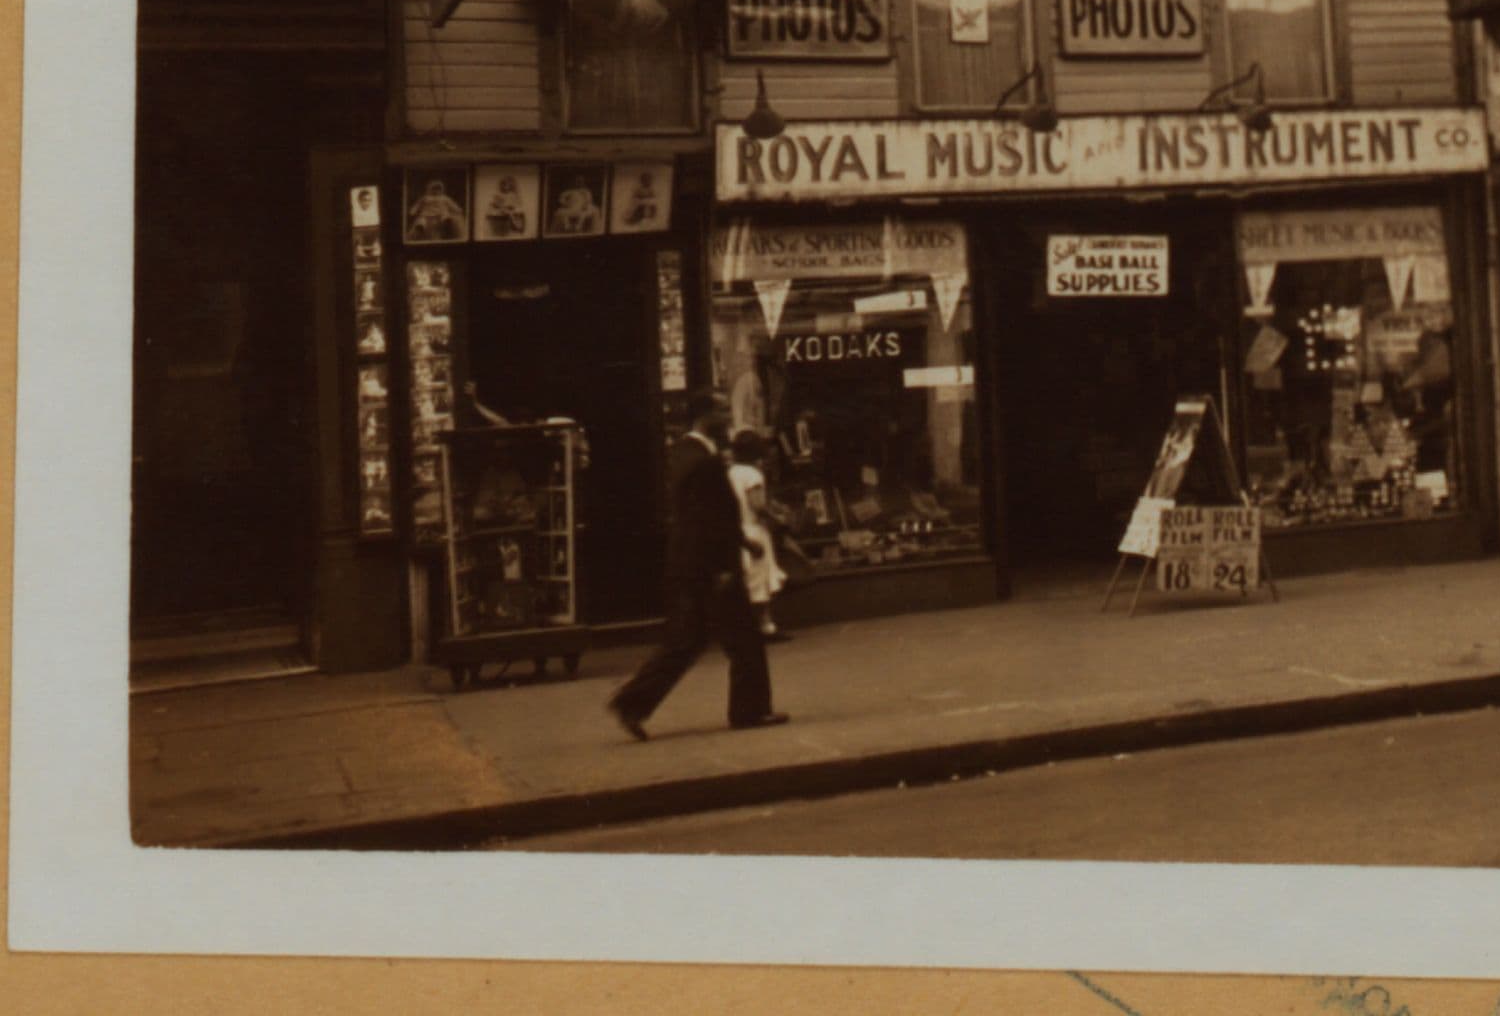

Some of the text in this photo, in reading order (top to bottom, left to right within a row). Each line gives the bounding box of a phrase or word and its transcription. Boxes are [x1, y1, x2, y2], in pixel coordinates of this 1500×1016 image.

[737, 135, 905, 184] ROYAL
[926, 130, 1067, 179] MUSIC
[1138, 118, 1422, 171] INSTRUMENT
[1435, 128, 1479, 148] CO.
[1075, 255, 1159, 269] BASE BALL
[1056, 274, 1160, 292] SUPPLIES
[786, 332, 901, 361] KODAKS
